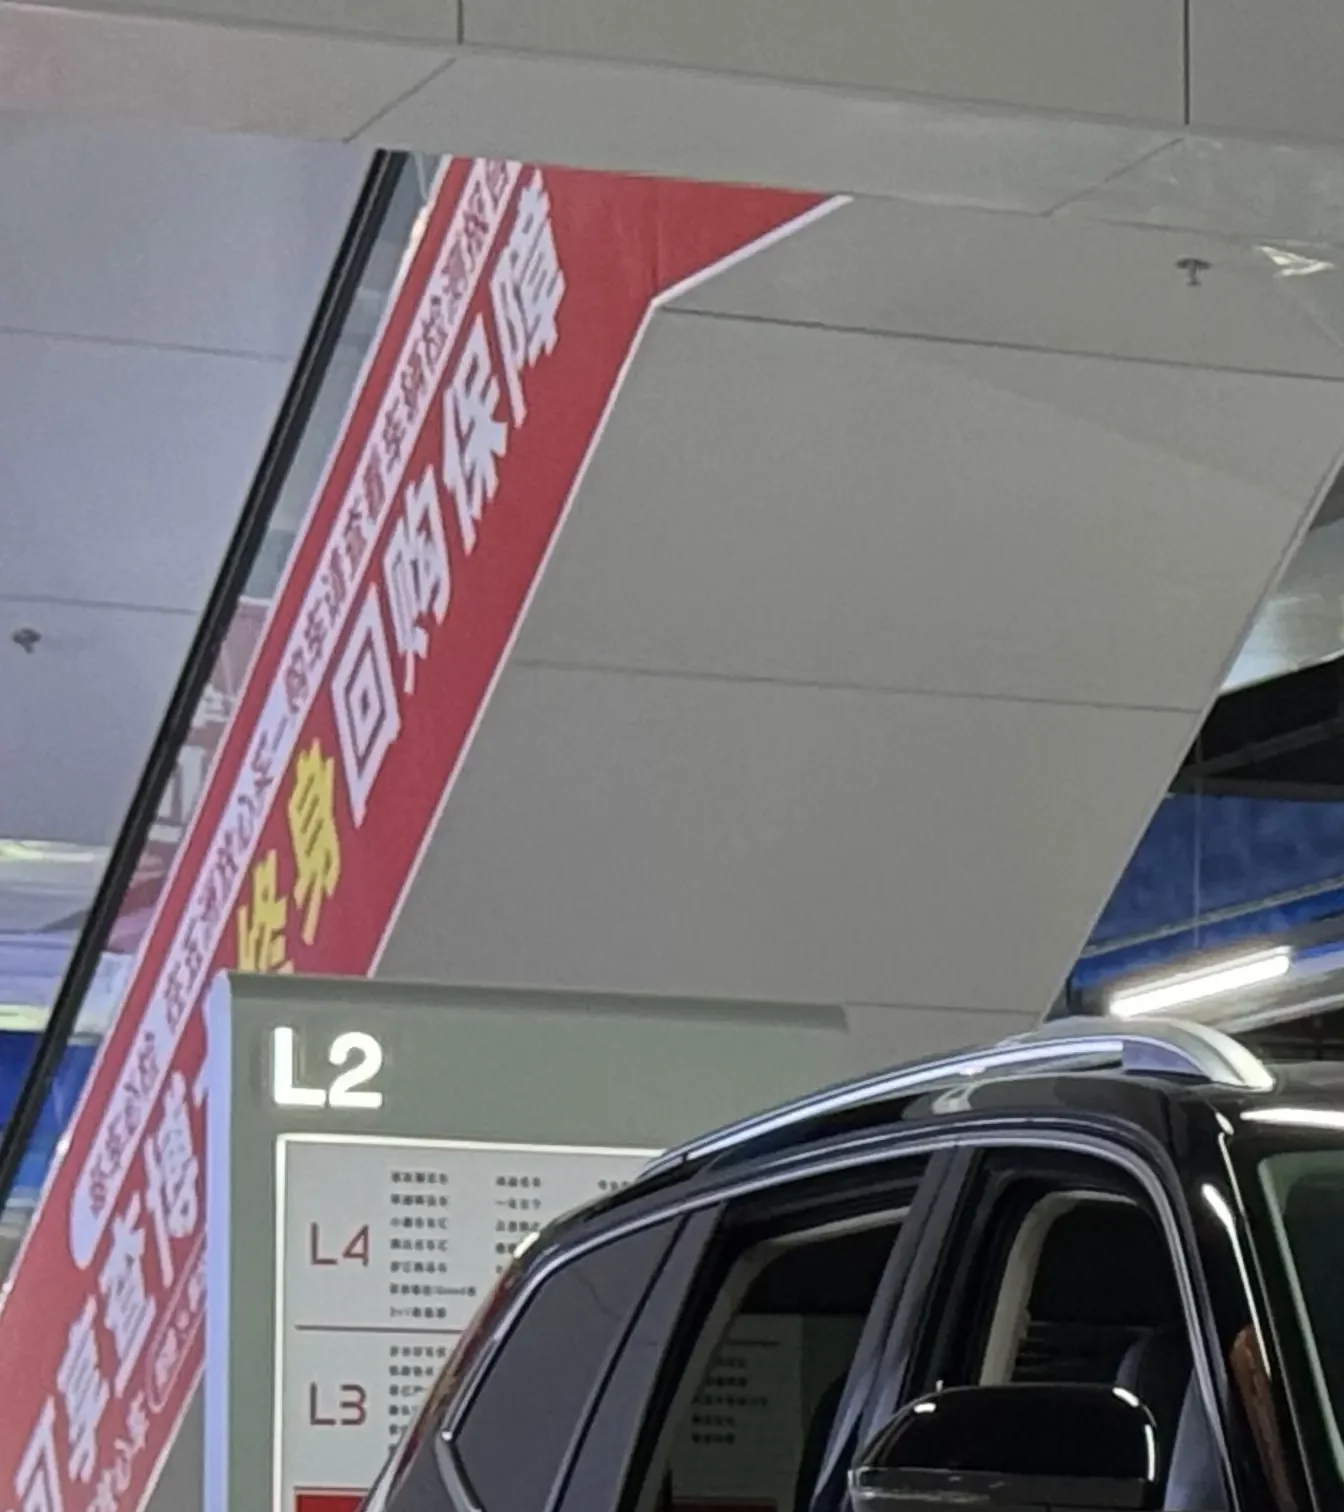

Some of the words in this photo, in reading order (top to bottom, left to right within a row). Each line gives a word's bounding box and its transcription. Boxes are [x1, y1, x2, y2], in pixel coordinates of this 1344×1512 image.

[273, 1026, 385, 1109] L2
[309, 1222, 370, 1267] L4
[308, 1382, 368, 1427] L3
